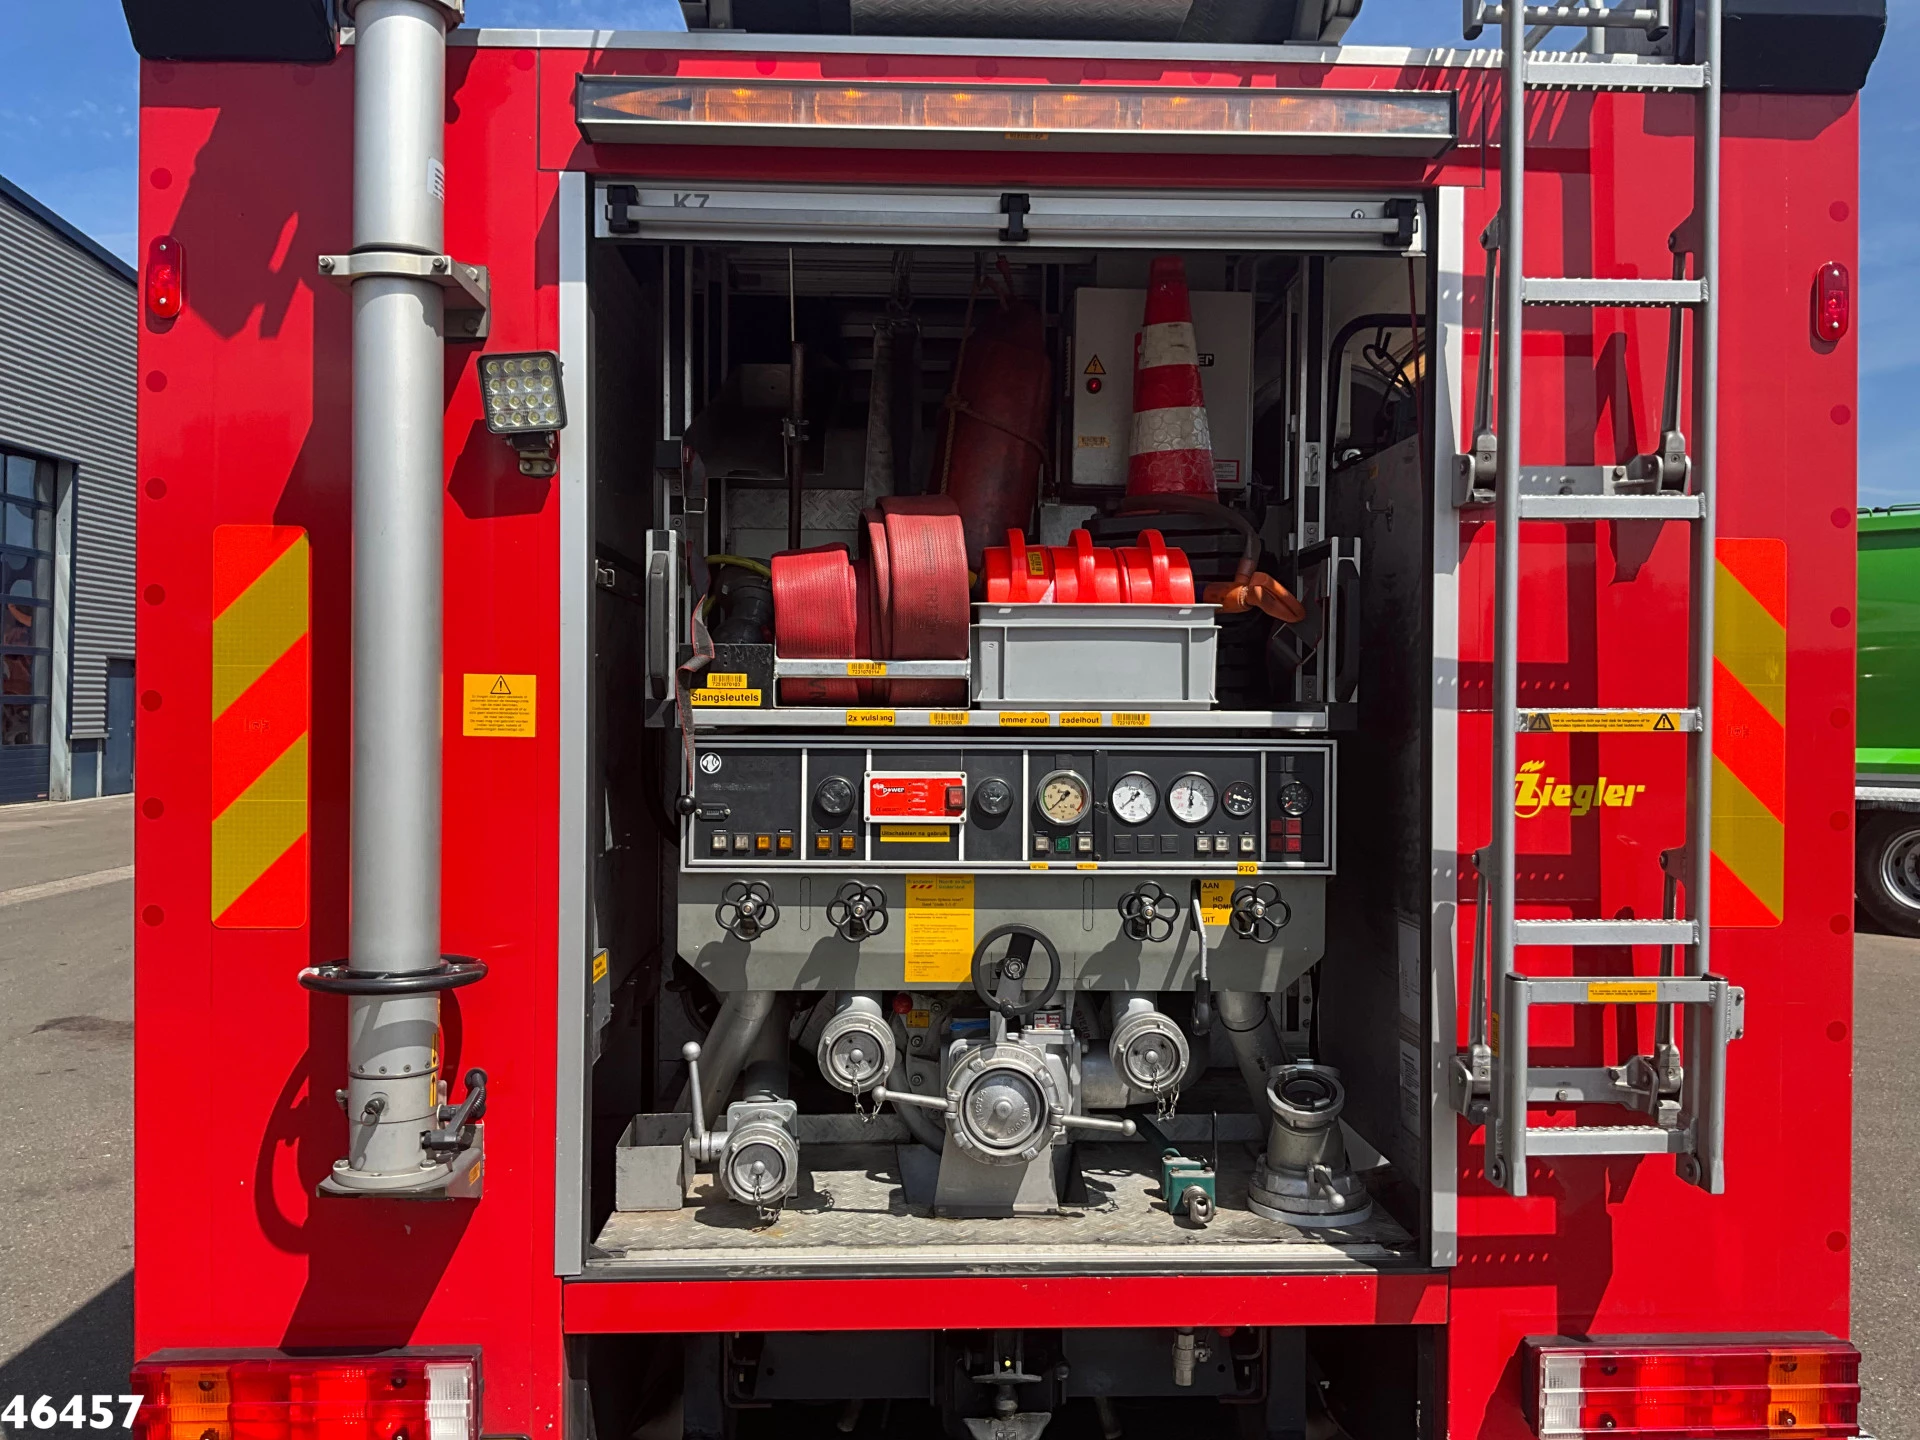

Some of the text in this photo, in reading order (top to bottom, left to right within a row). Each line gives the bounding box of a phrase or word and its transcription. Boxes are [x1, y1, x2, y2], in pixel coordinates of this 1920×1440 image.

[691, 692, 759, 703] Slangsleutels
[847, 713, 893, 723] 2x vulslang
[1000, 715, 1048, 724] emmer zout
[1061, 715, 1100, 724] zadelhout
[1515, 771, 1646, 817] Ziegler
[927, 830, 947, 838] gebruik
[1238, 865, 1256, 873] PTO
